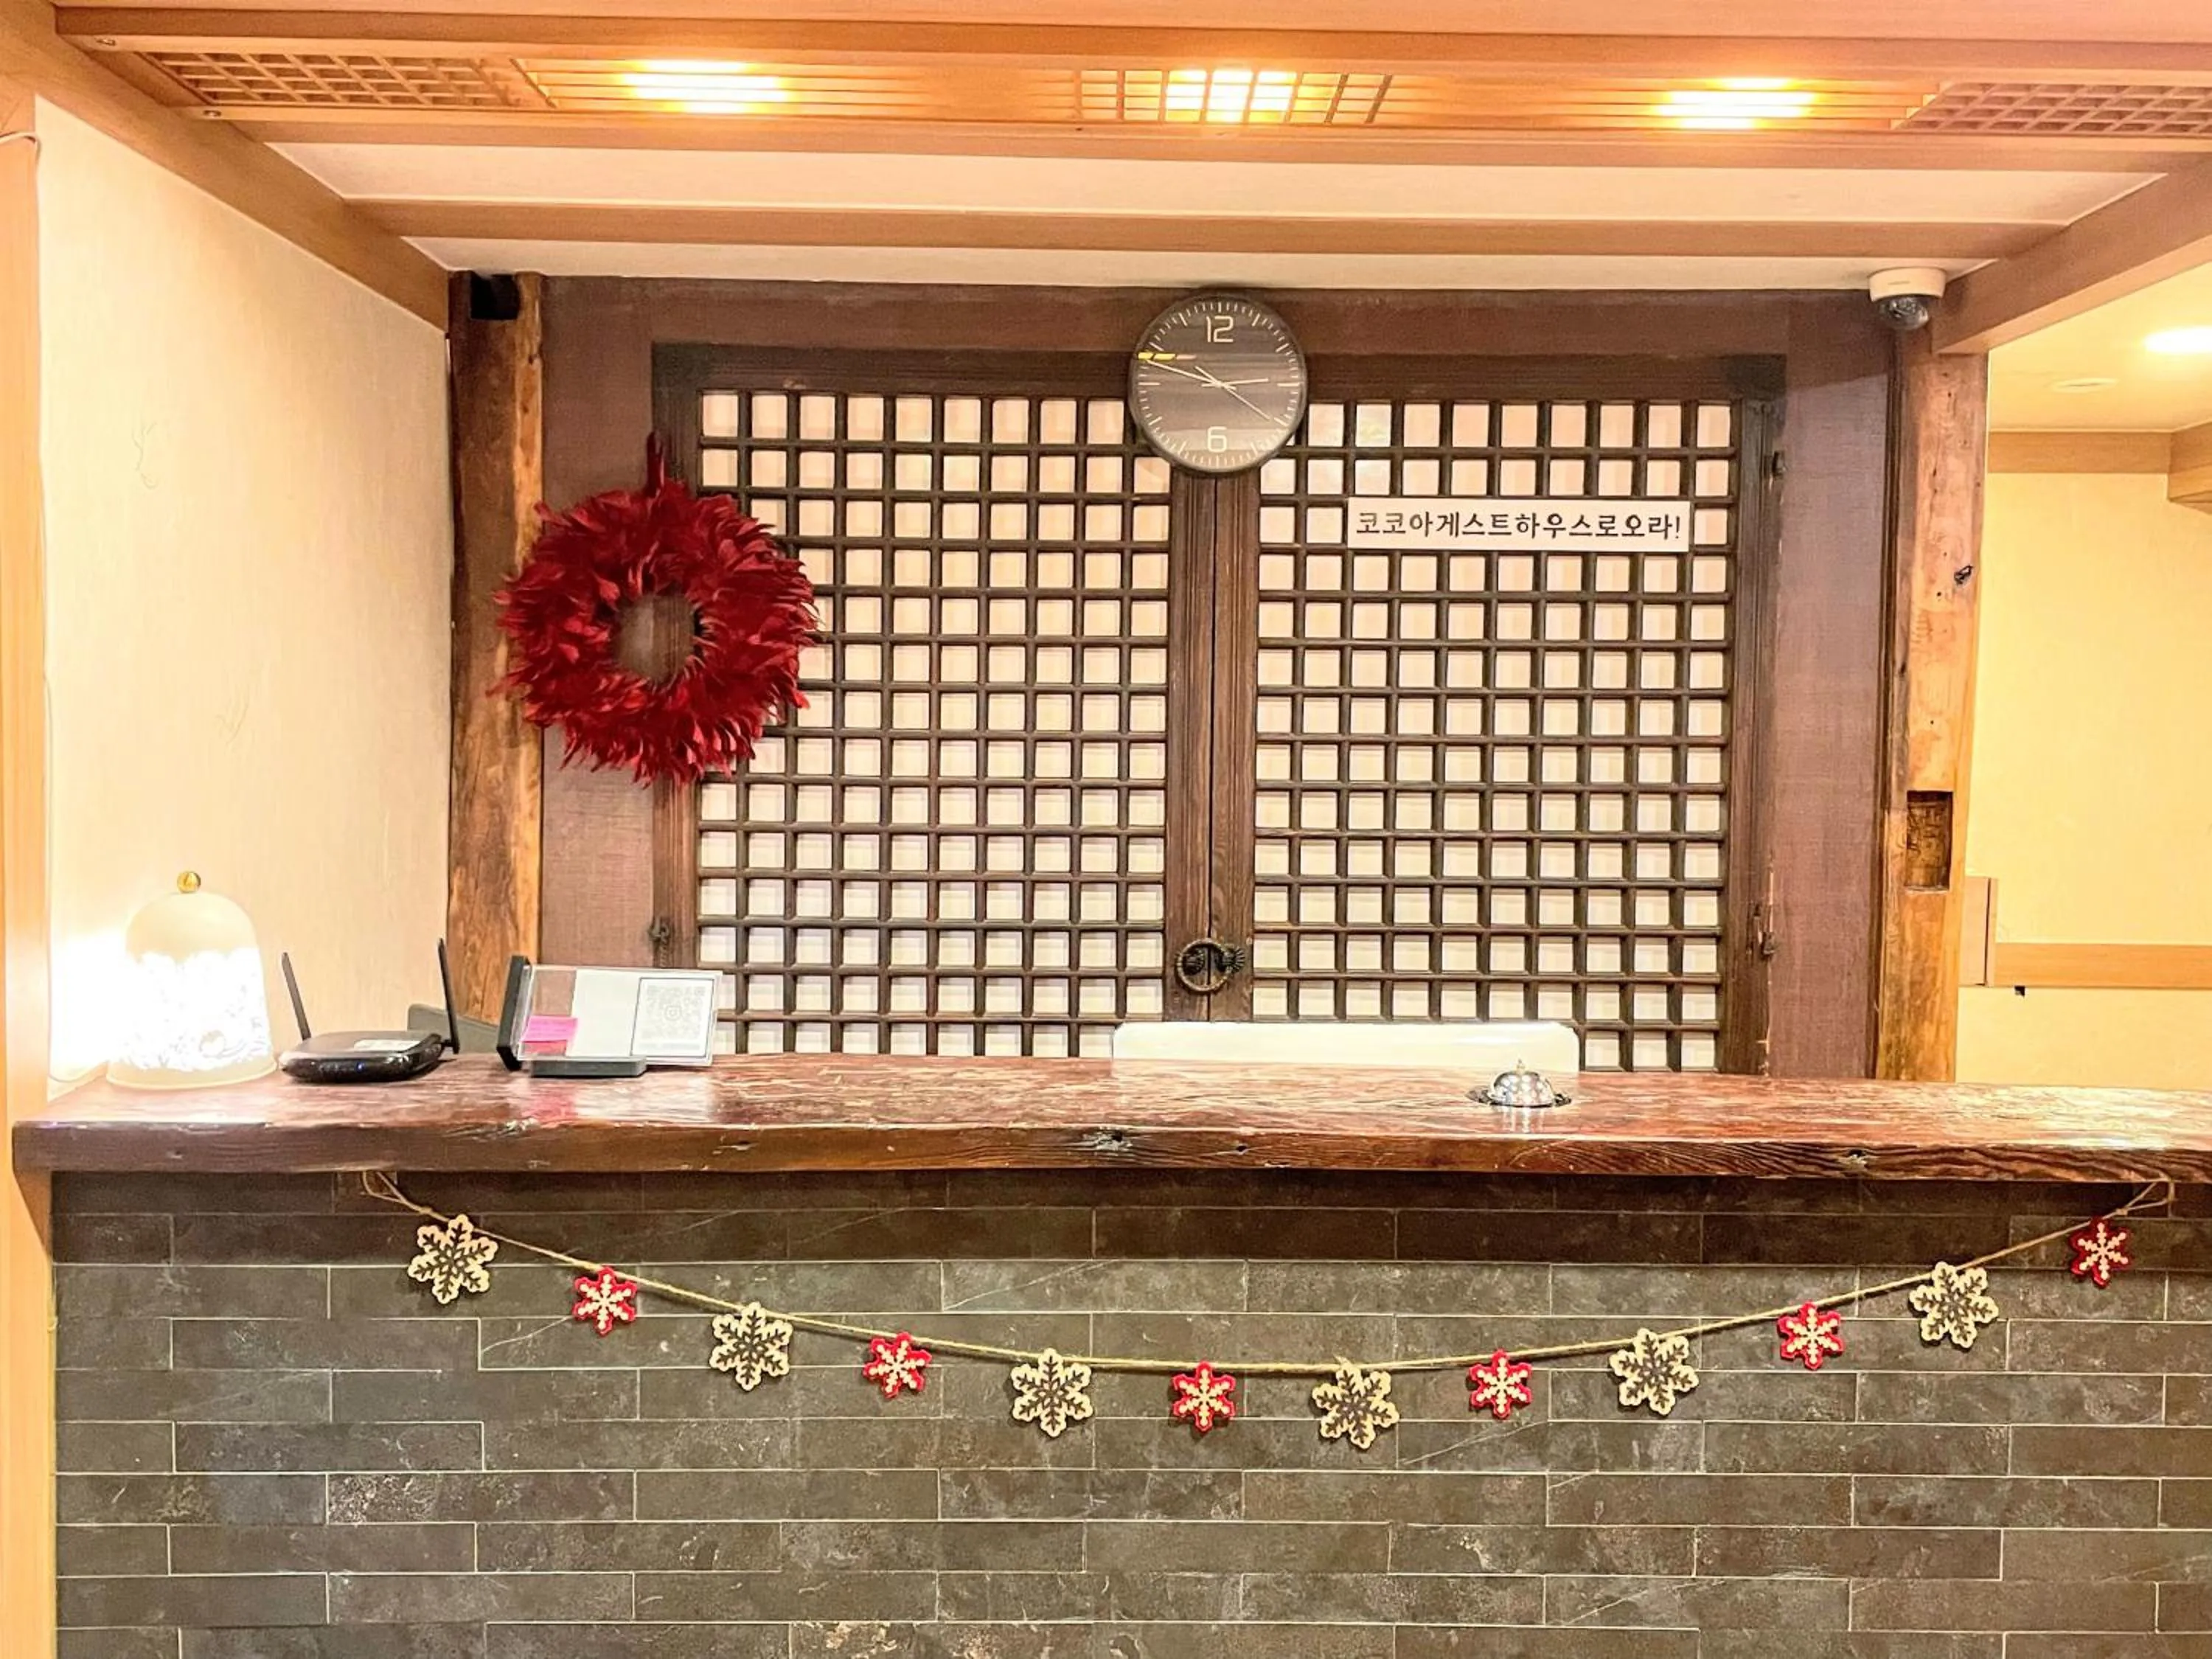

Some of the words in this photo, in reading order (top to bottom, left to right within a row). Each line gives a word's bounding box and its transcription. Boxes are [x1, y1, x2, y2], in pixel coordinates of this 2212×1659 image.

[1206, 316, 1234, 343] 12
[1207, 426, 1227, 453] 6
[1356, 511, 1680, 540] 코코아게스트하우스로오라!
